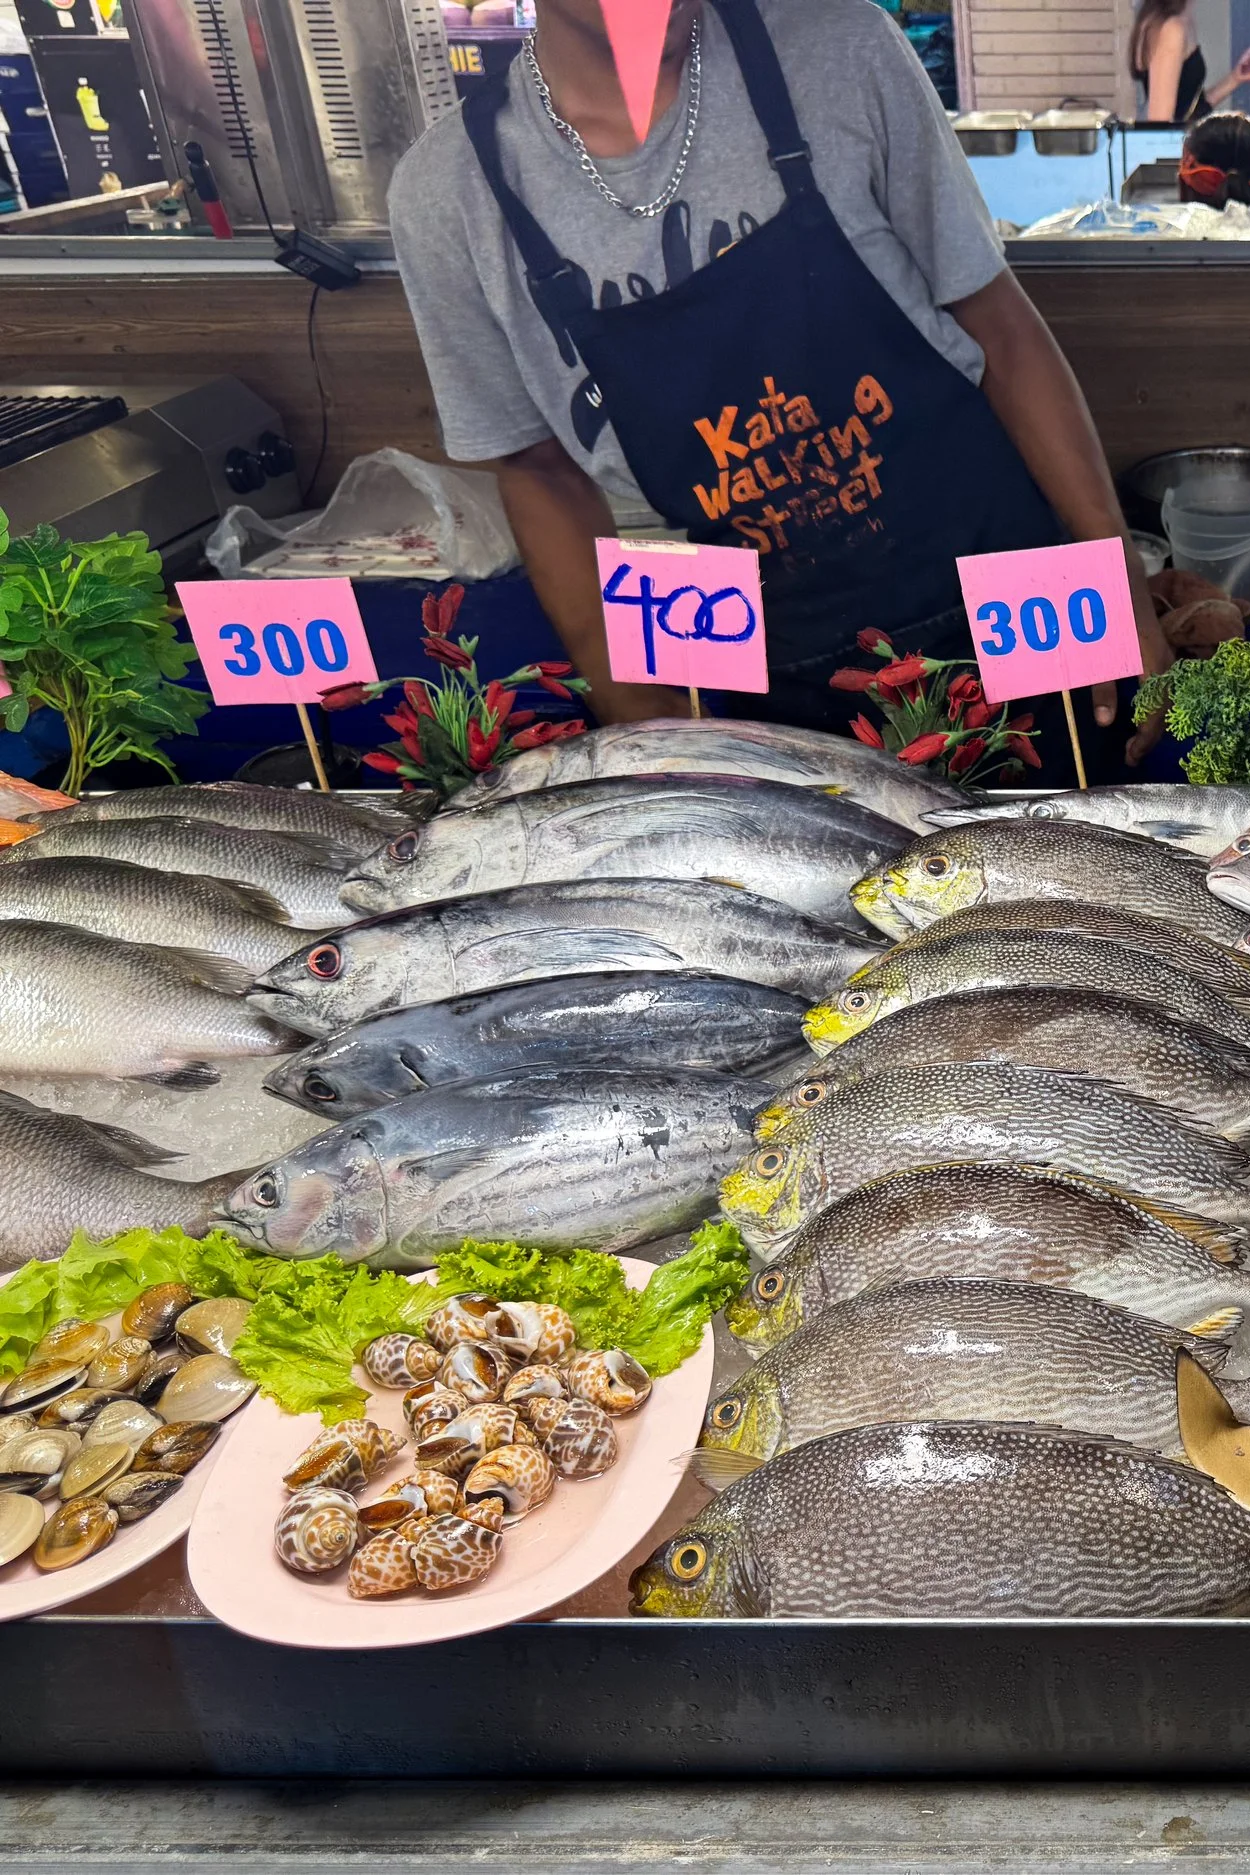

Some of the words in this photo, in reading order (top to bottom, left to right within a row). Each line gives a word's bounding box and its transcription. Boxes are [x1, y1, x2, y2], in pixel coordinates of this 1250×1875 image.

[693, 376, 820, 469] Kata
[219, 619, 349, 676] 300
[603, 563, 755, 676] 400
[976, 587, 1107, 656] 300
